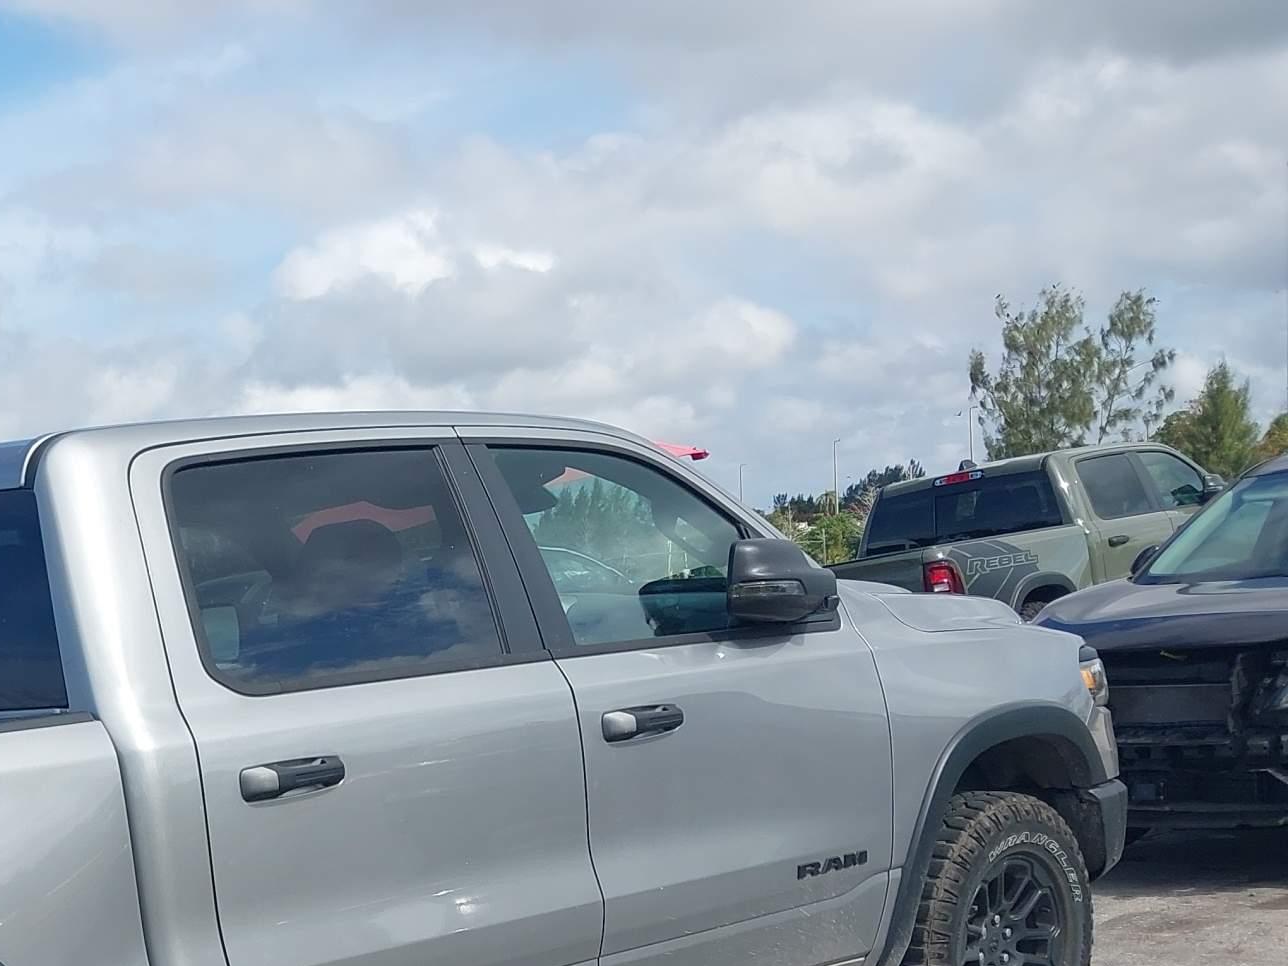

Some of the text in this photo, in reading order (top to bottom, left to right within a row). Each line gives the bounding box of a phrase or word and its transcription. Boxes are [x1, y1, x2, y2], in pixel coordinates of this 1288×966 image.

[966, 551, 1039, 575] REBEL
[797, 850, 868, 880] RAM
[988, 831, 1083, 903] WRANGLER
